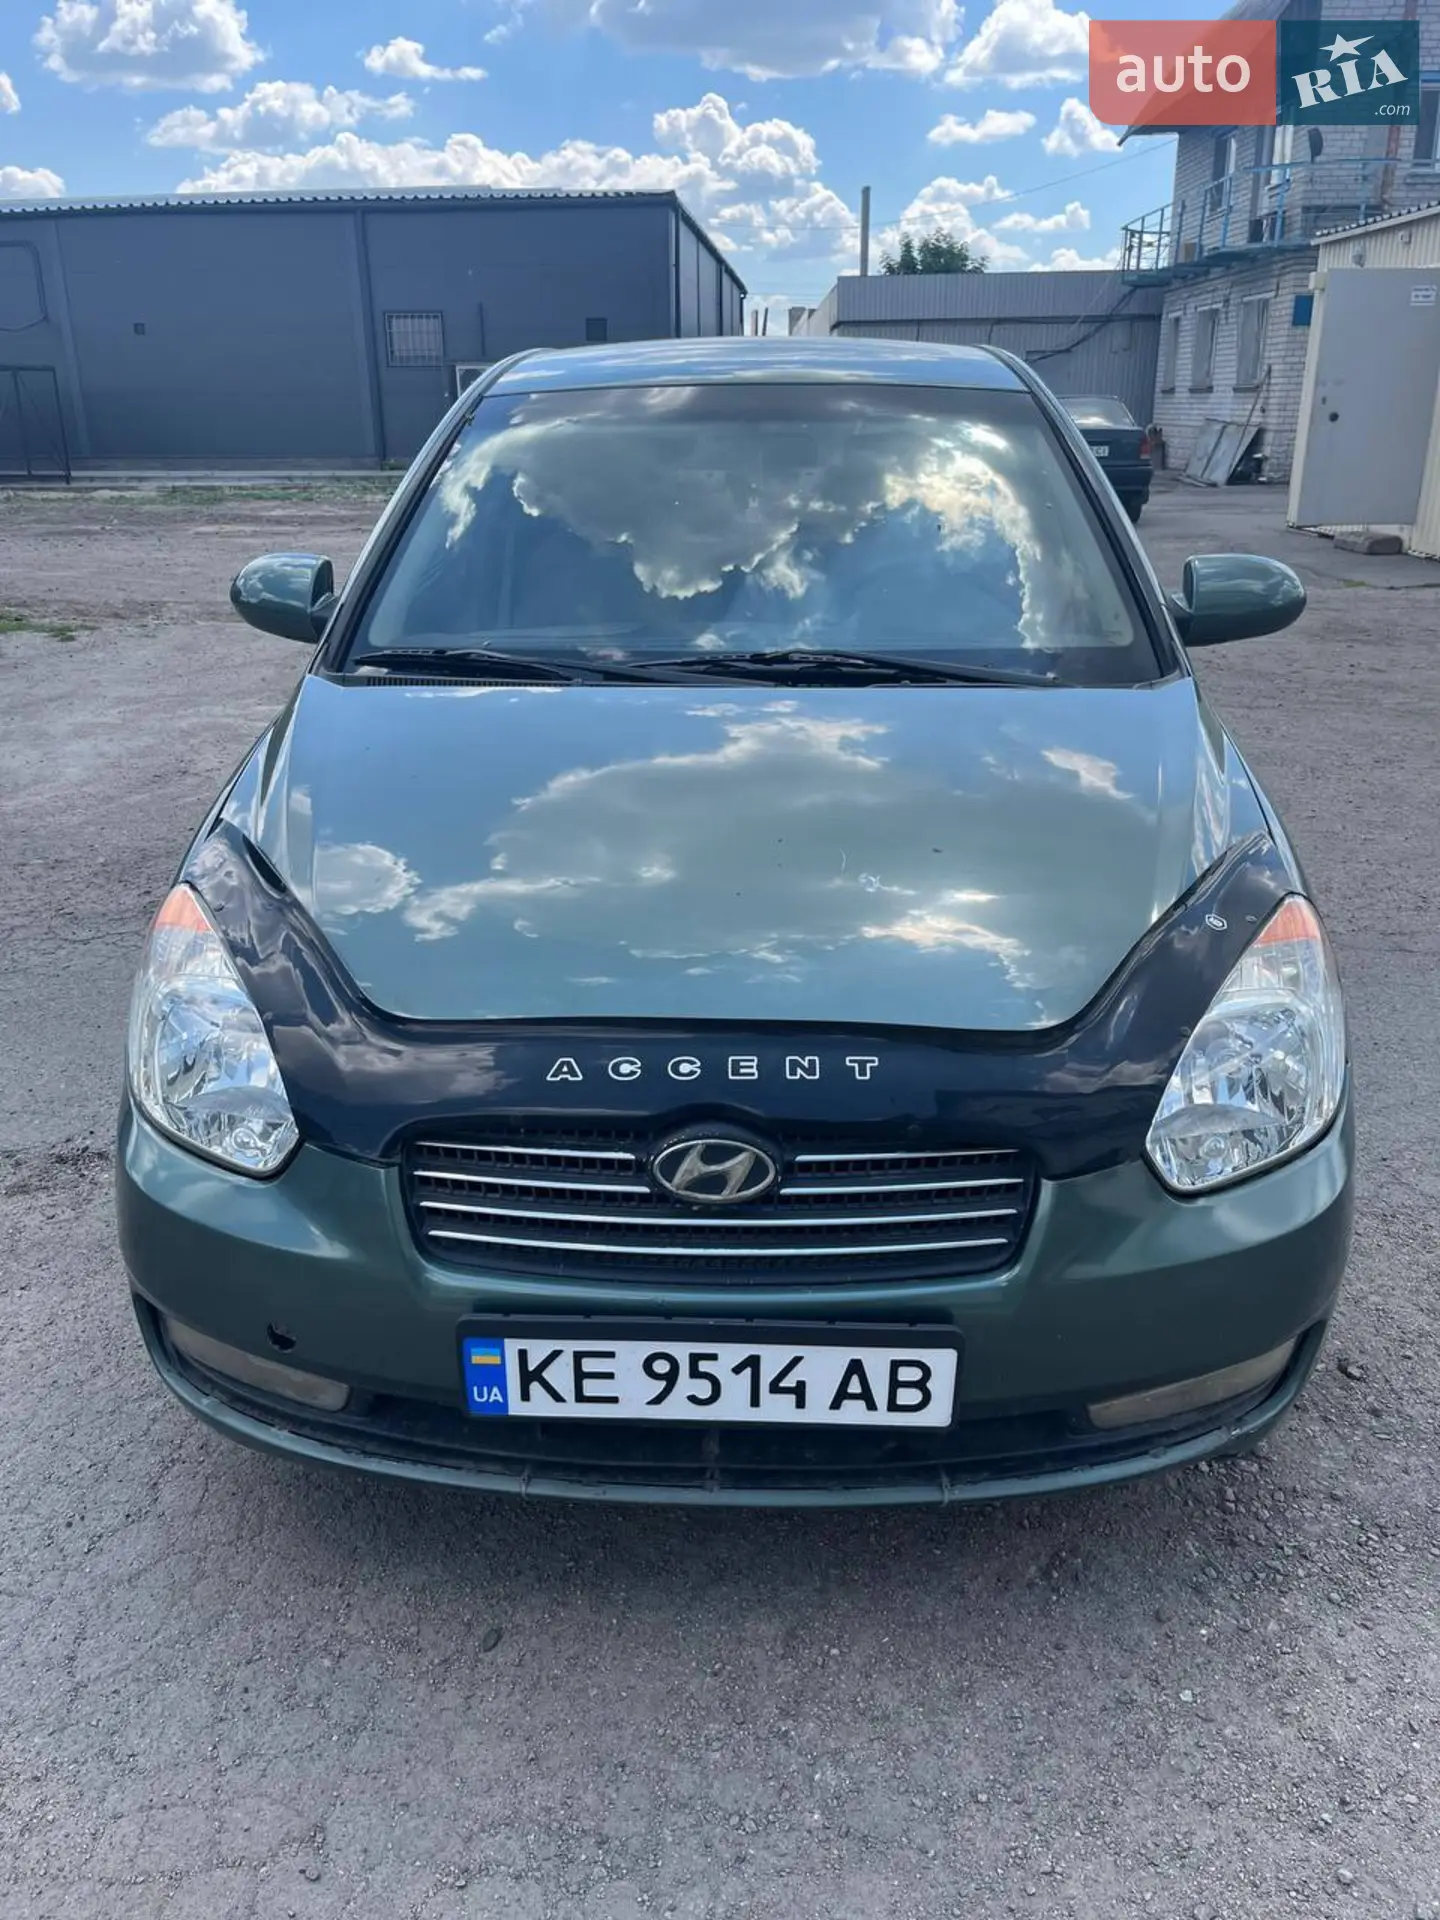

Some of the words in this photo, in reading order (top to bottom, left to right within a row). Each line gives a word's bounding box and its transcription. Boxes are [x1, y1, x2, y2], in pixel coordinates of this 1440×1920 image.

[546, 1056, 879, 1080] ACCENT
[516, 1348, 620, 1404] KE
[642, 1351, 807, 1410] 9514
[828, 1358, 933, 1414] AB
[472, 1386, 504, 1403] UA
